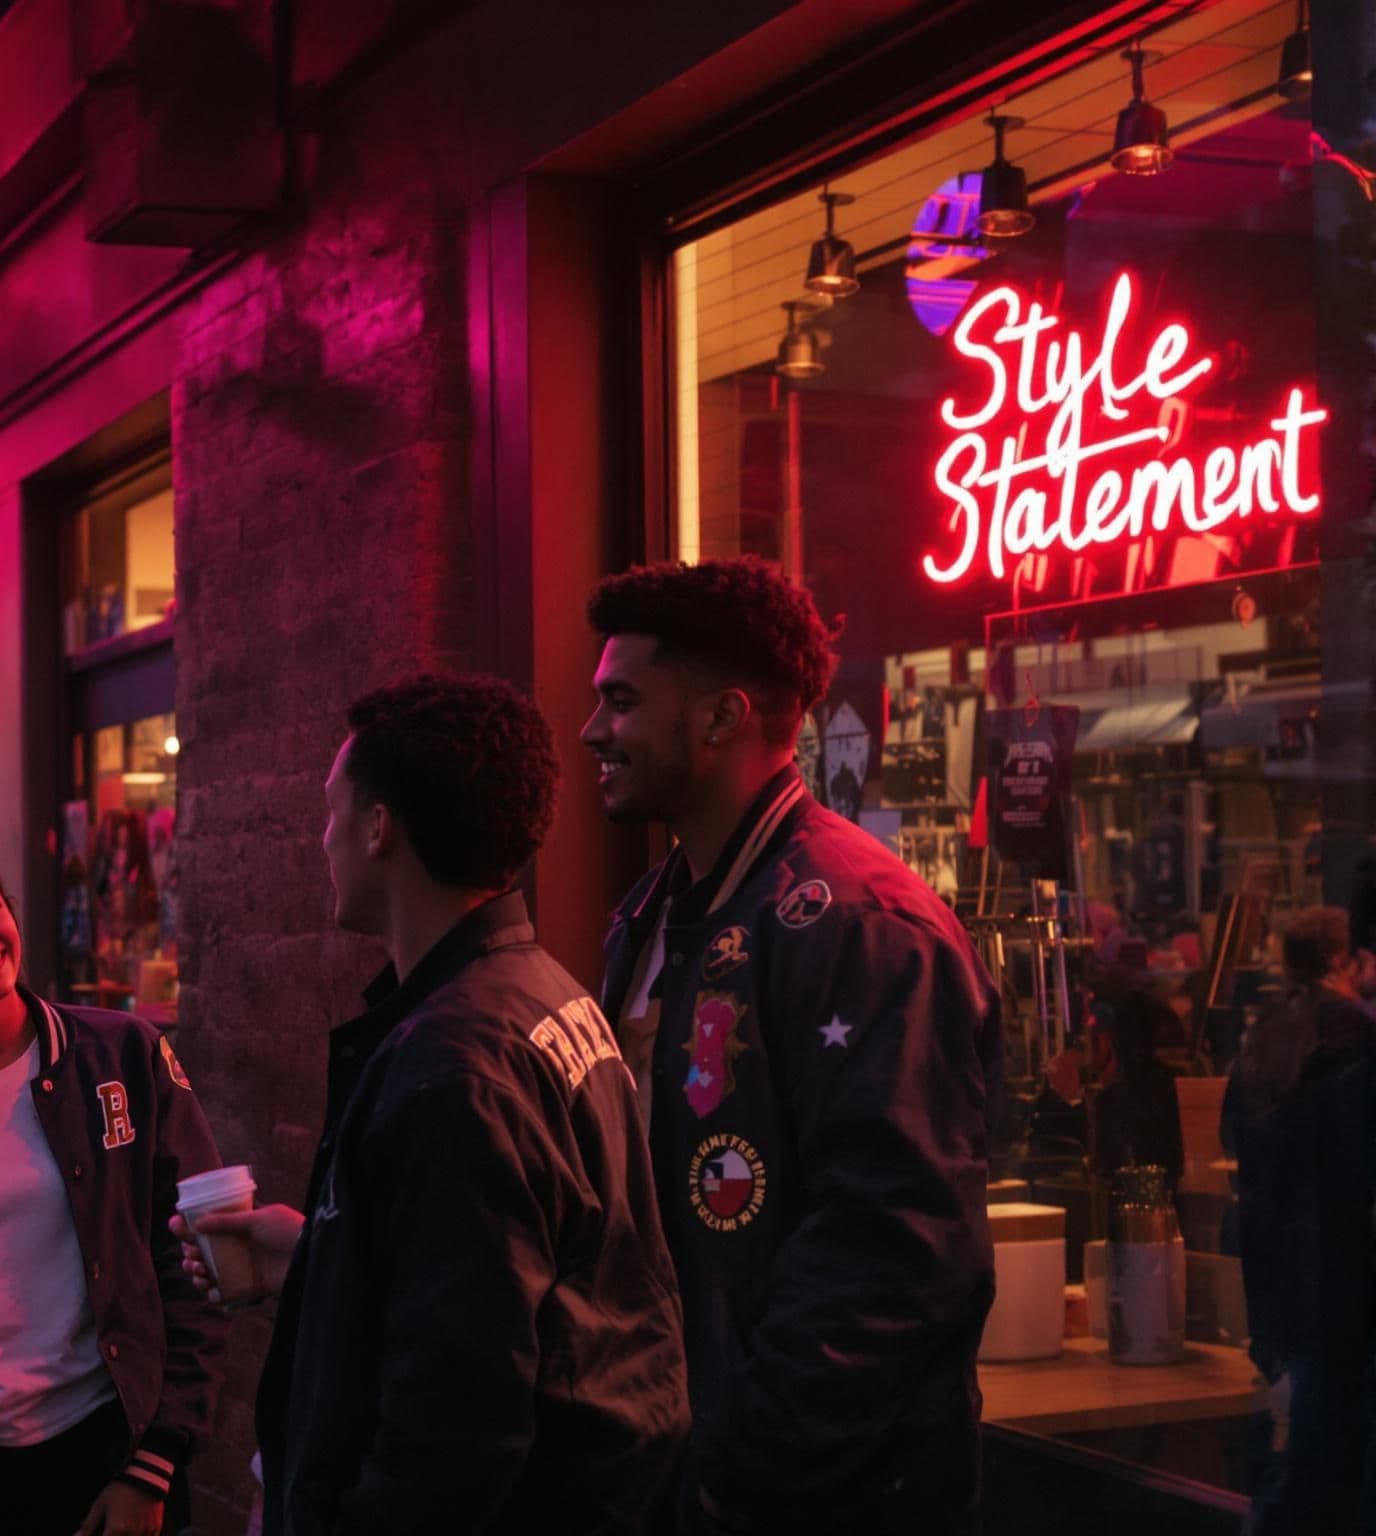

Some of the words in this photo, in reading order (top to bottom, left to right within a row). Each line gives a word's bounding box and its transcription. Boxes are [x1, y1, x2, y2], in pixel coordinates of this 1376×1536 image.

[941, 273, 1212, 477] Style
[924, 388, 1327, 582] Statement
[96, 1081, 135, 1149] R
